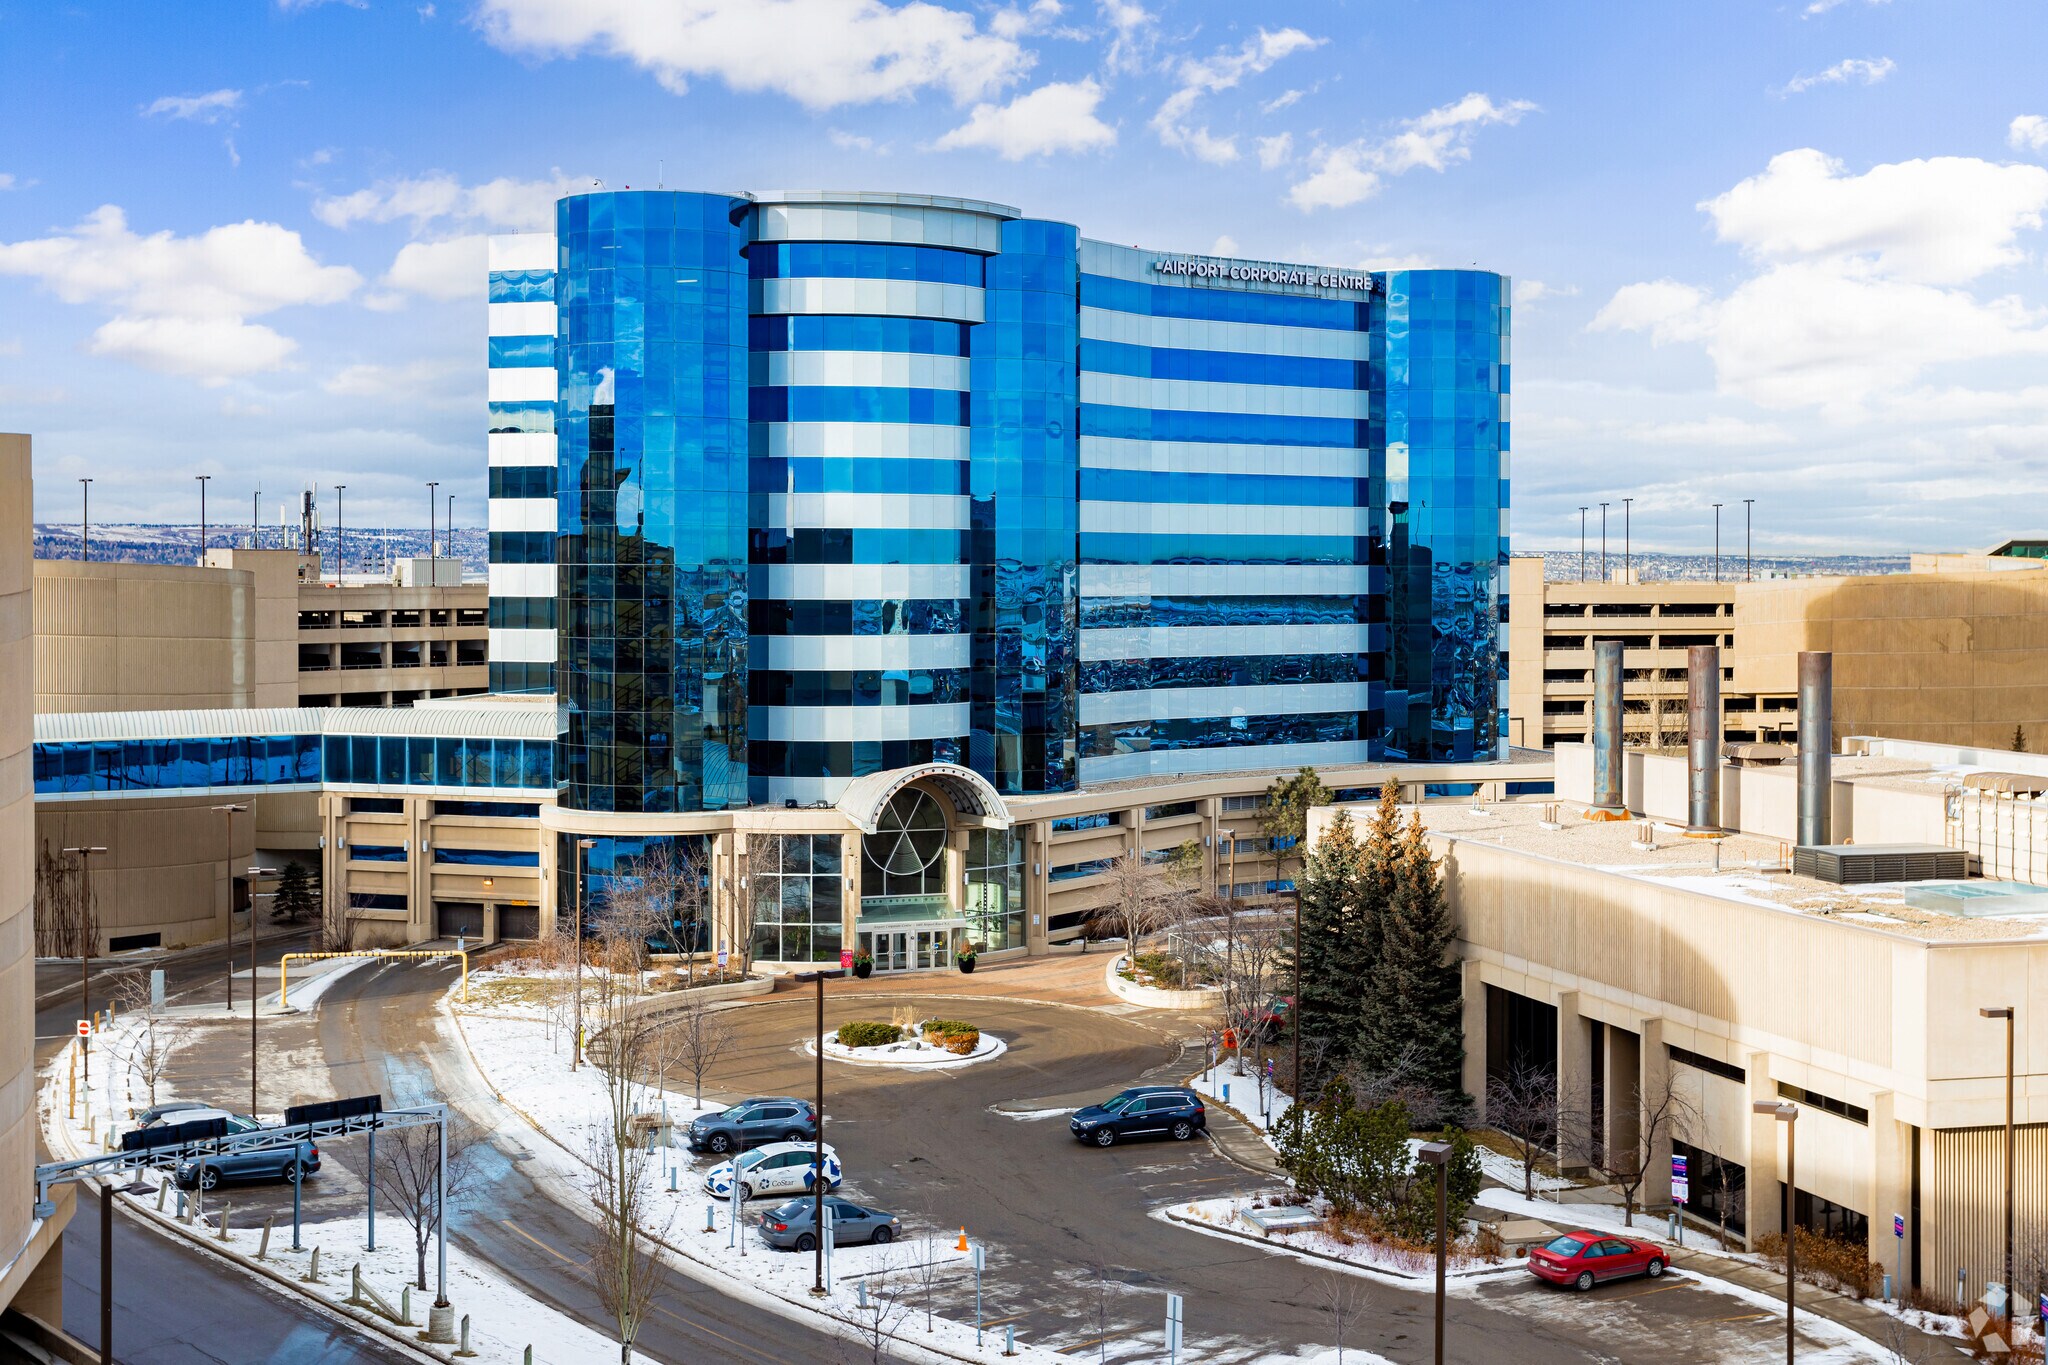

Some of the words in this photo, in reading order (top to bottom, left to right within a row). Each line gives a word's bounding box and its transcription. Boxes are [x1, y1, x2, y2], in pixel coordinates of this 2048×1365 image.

[1162, 260, 1225, 279] AIRPORT
[1228, 266, 1314, 287] CORPORATE
[1319, 273, 1372, 291] CENTRE
